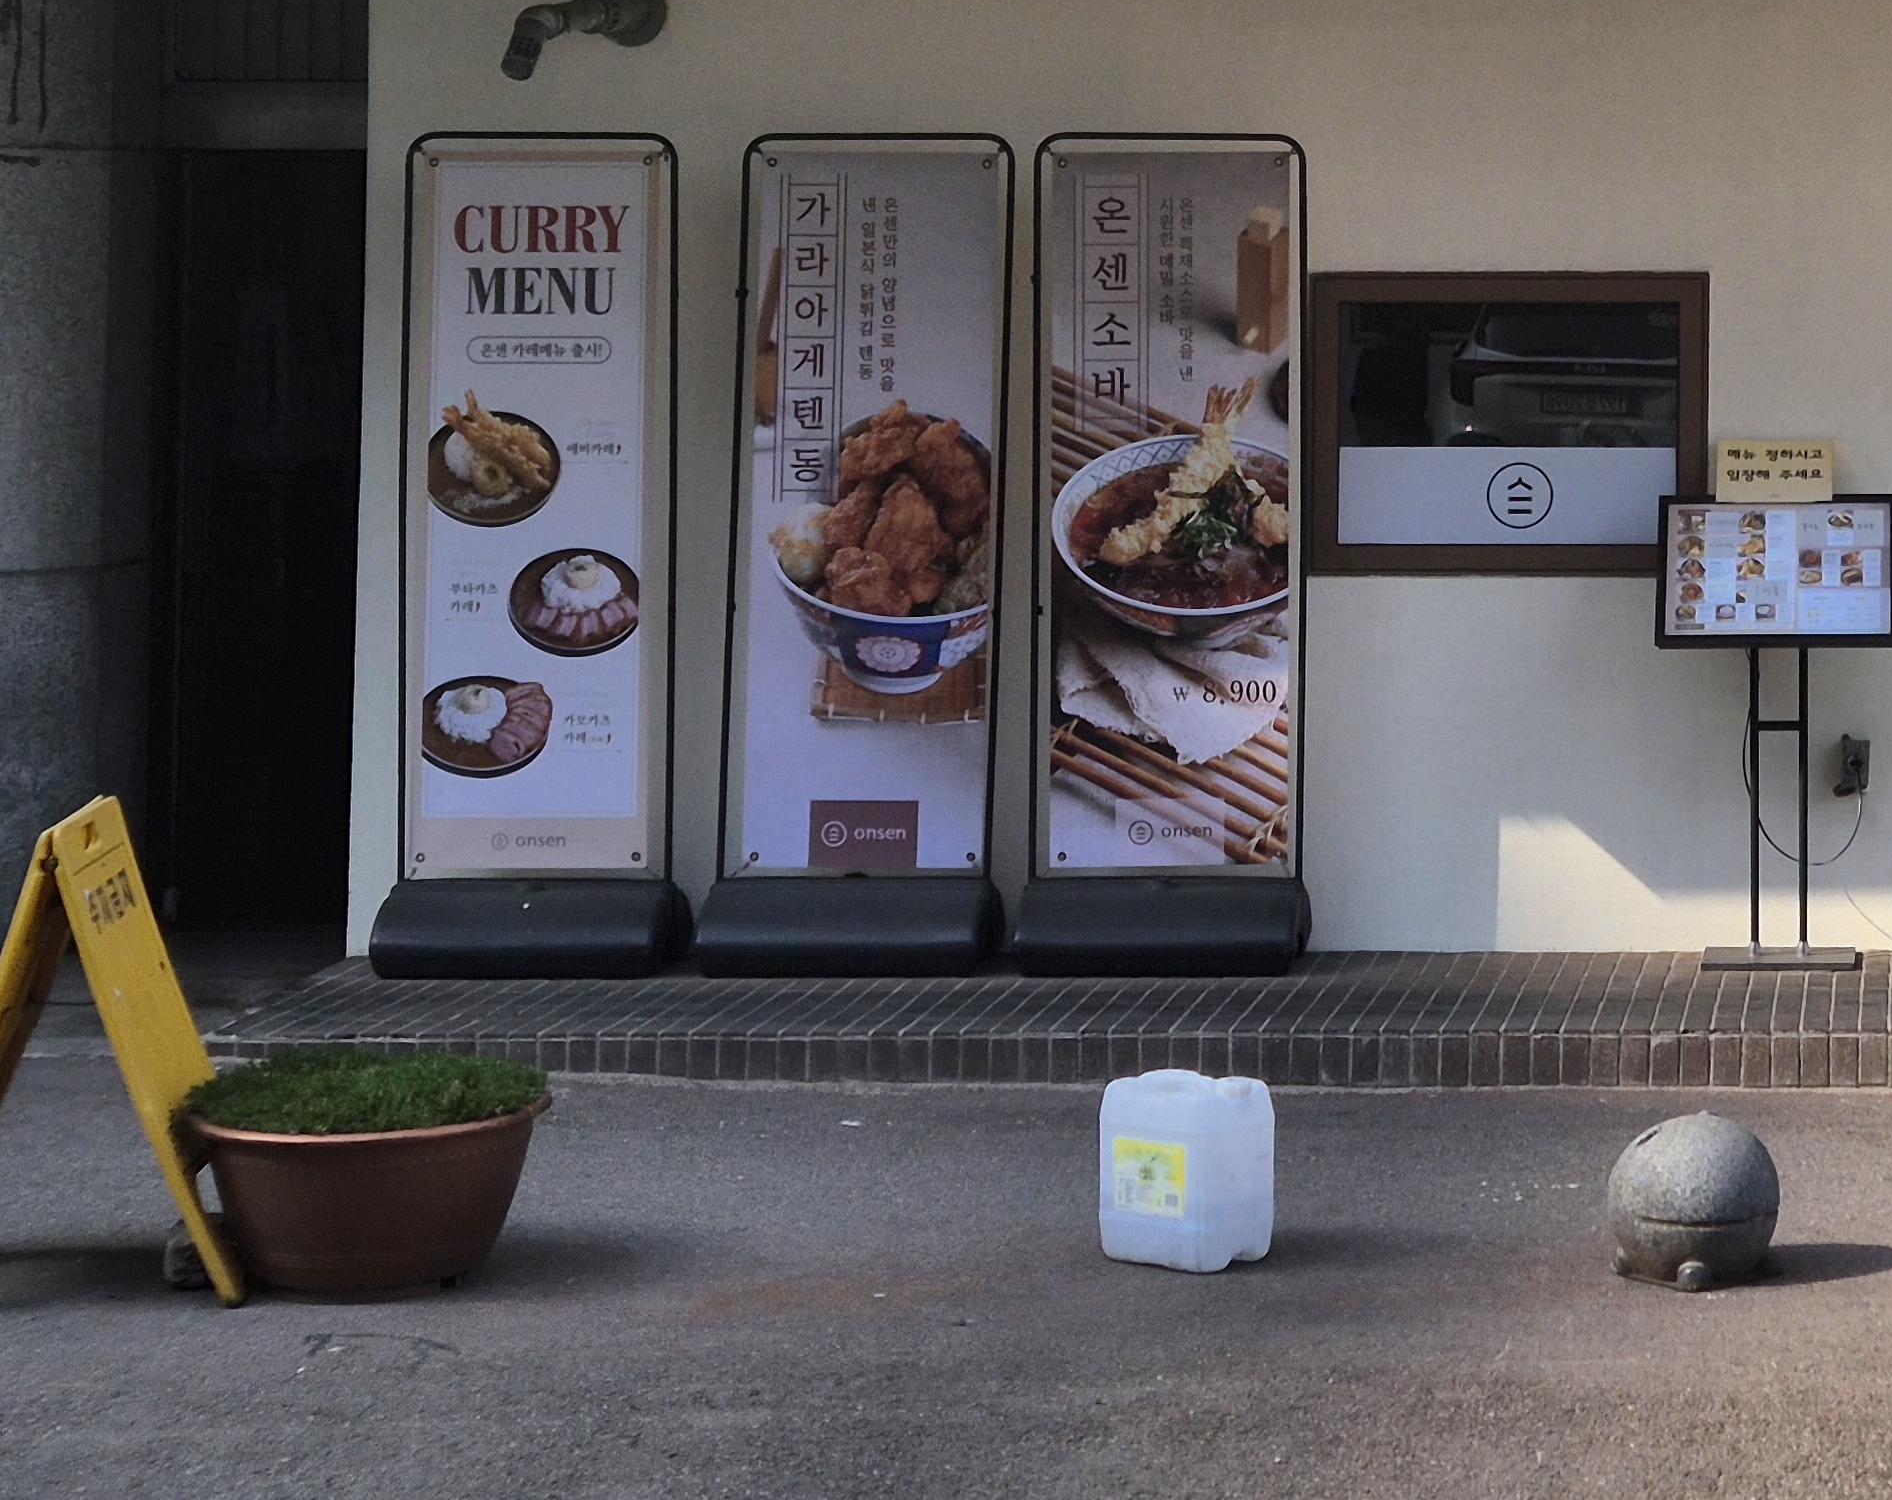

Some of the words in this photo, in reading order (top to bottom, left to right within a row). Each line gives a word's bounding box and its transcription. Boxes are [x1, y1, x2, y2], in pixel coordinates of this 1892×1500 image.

[454, 205, 630, 253] CURRY
[465, 267, 615, 315] MENU
[1091, 196, 1132, 406] 온센소바
[789, 192, 832, 483] 가라아게텐동
[1727, 449, 1756, 460] 메뉴
[1778, 469, 1824, 480] 주세요
[853, 826, 907, 840] onsen
[1160, 824, 1213, 838] onsen
[515, 835, 566, 848] onsen
